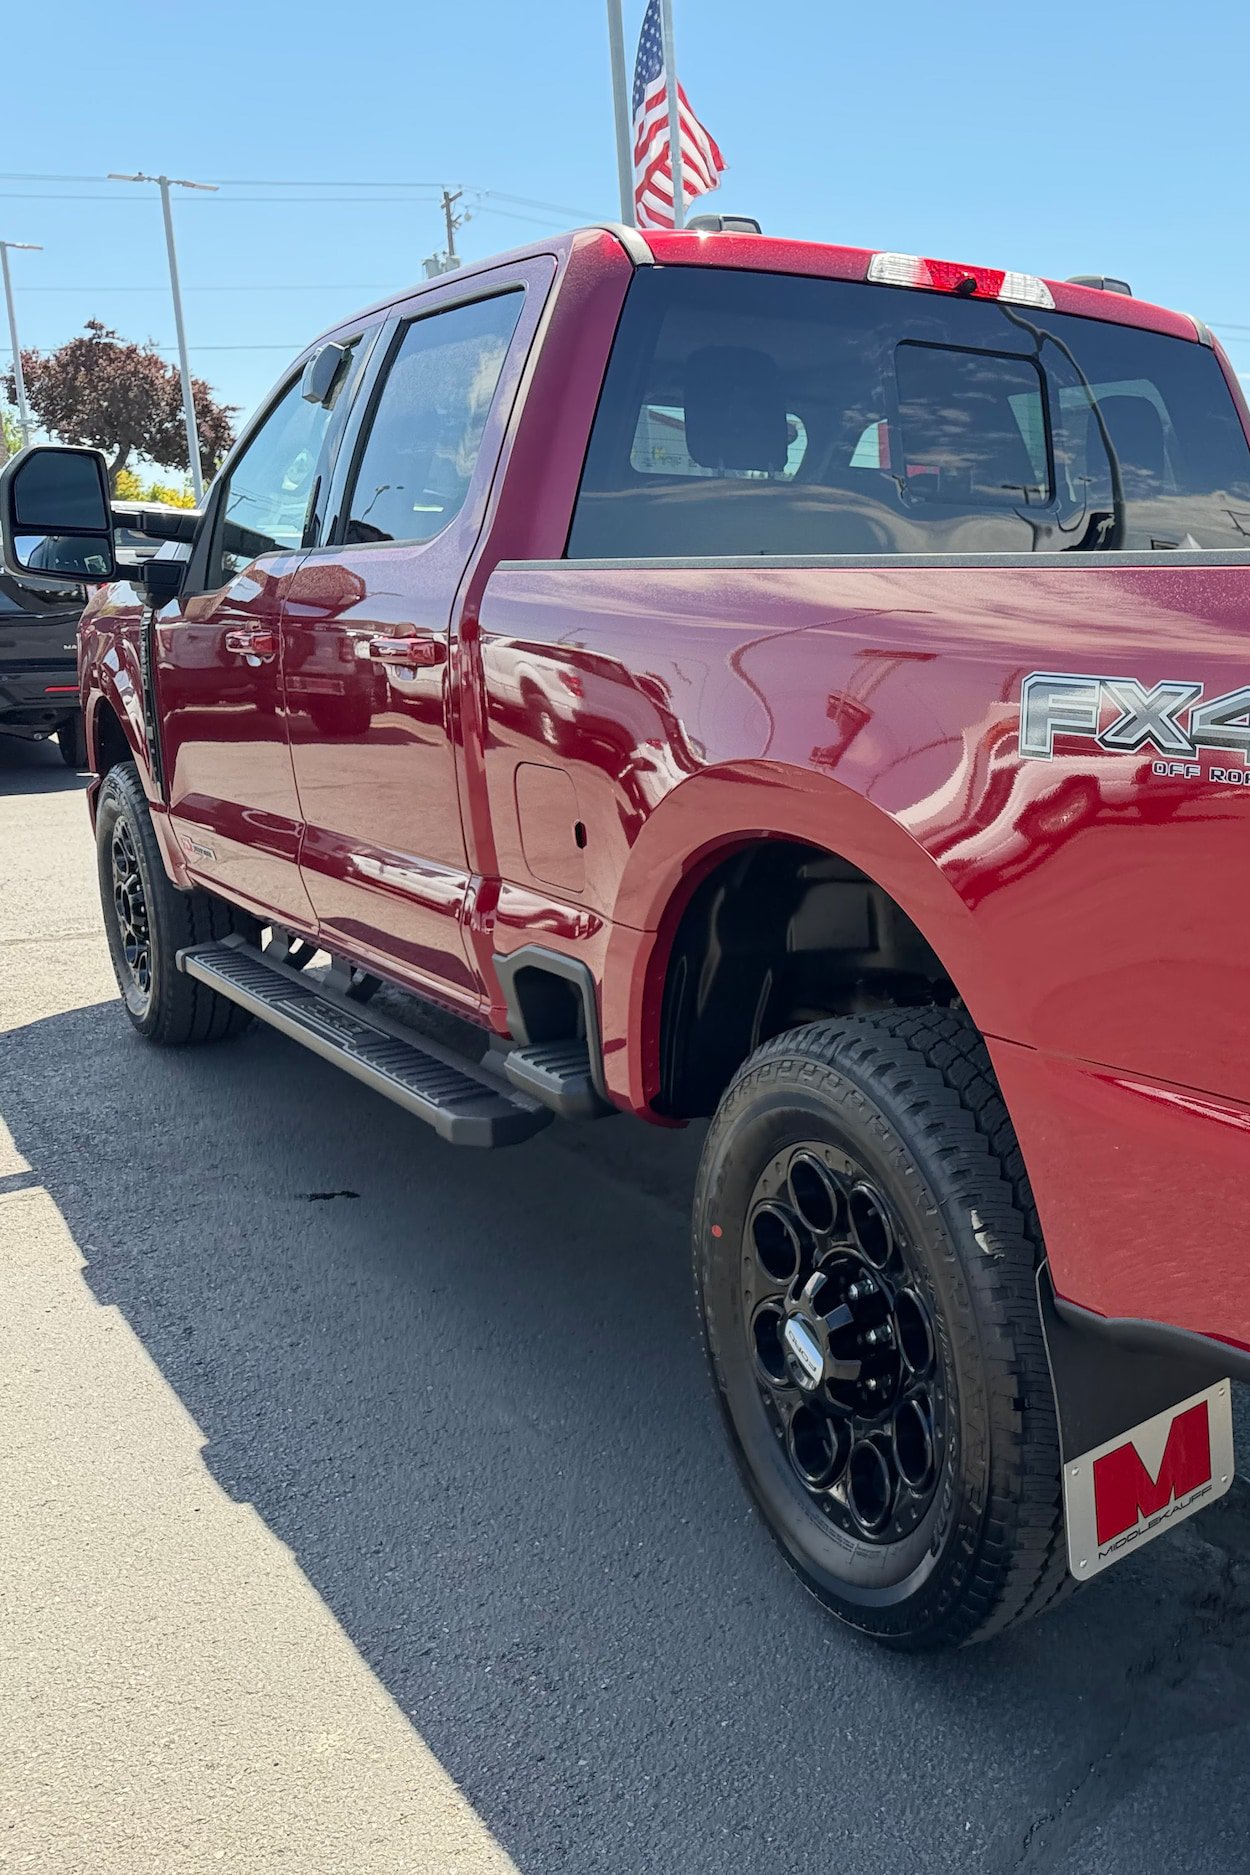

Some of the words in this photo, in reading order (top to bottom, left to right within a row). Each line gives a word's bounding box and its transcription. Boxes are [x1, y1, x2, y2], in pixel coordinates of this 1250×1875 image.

[1152, 761, 1201, 778] OFF
[1093, 1400, 1211, 1546] M
[1098, 1485, 1212, 1559] MIDDLEKAUFF
